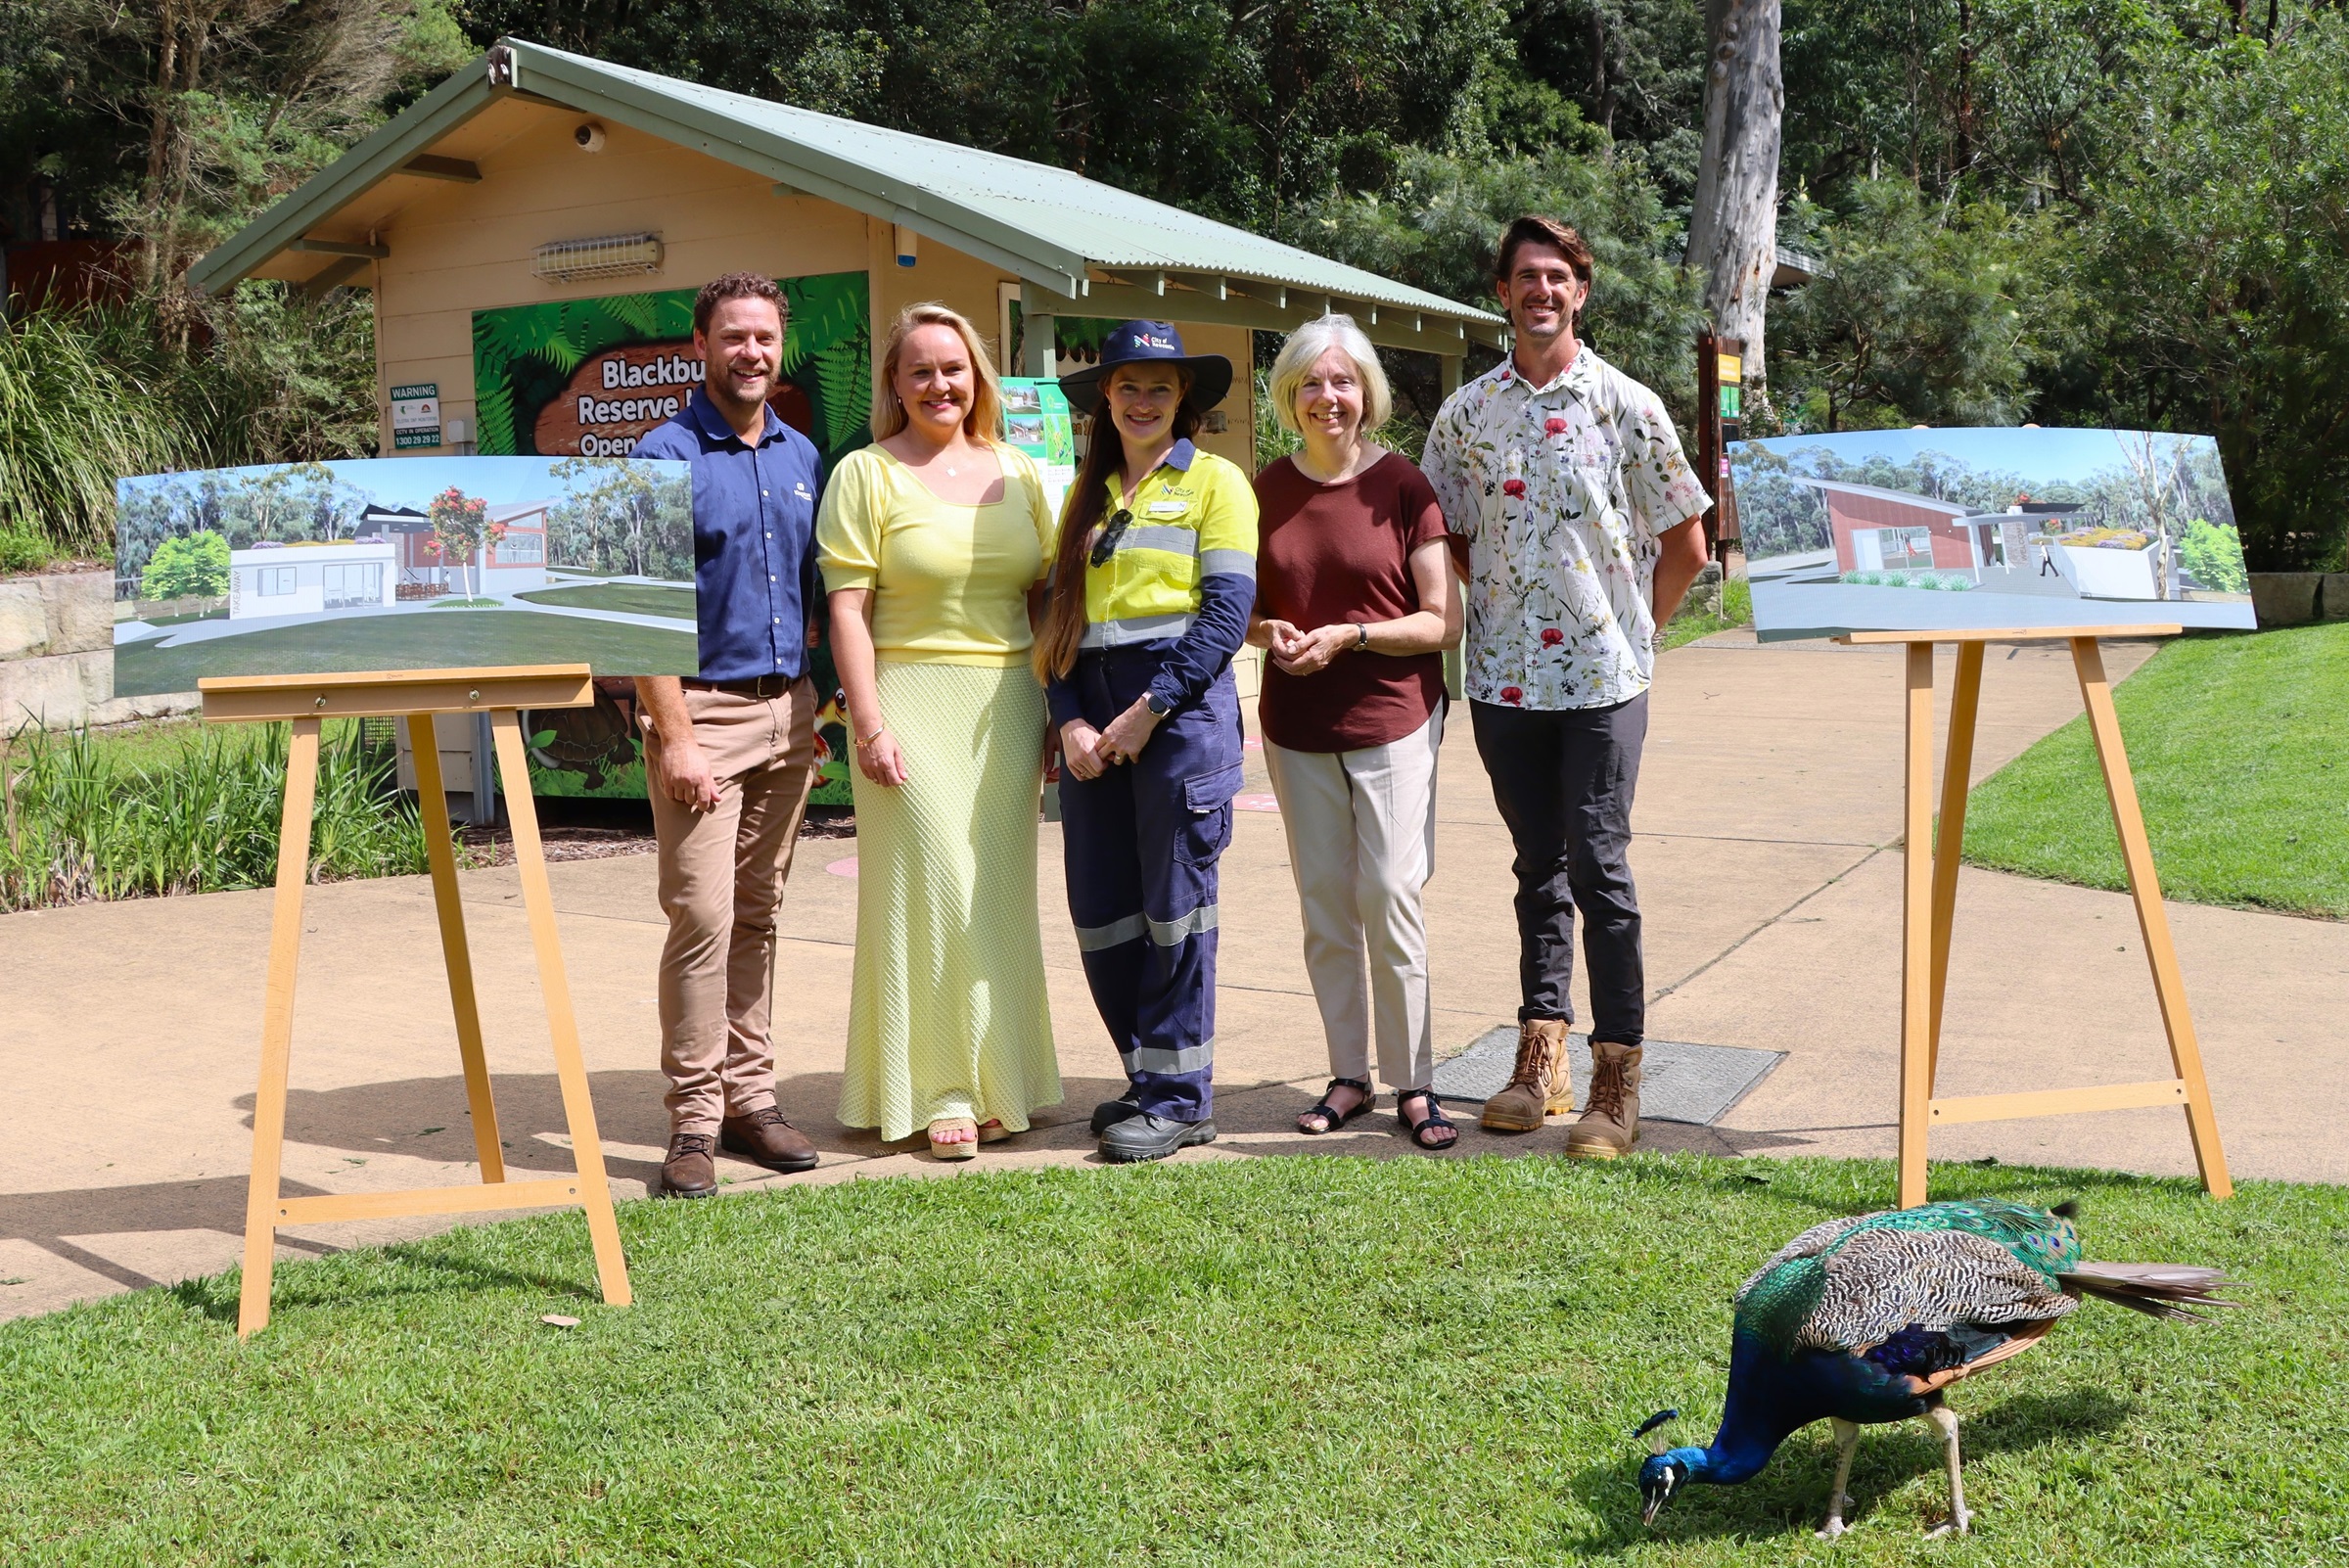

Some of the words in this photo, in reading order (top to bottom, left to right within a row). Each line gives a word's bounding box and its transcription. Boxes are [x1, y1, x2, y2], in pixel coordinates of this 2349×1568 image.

[602, 354, 705, 390] Blackbu
[392, 386, 435, 398] WARNING
[578, 396, 679, 424] Reserve
[396, 437, 411, 445] 1300
[413, 436, 421, 444] 29
[422, 435, 431, 443] 29
[432, 435, 439, 443] 22
[580, 434, 637, 457] Open
[232, 570, 241, 615] TAKEAWAY
